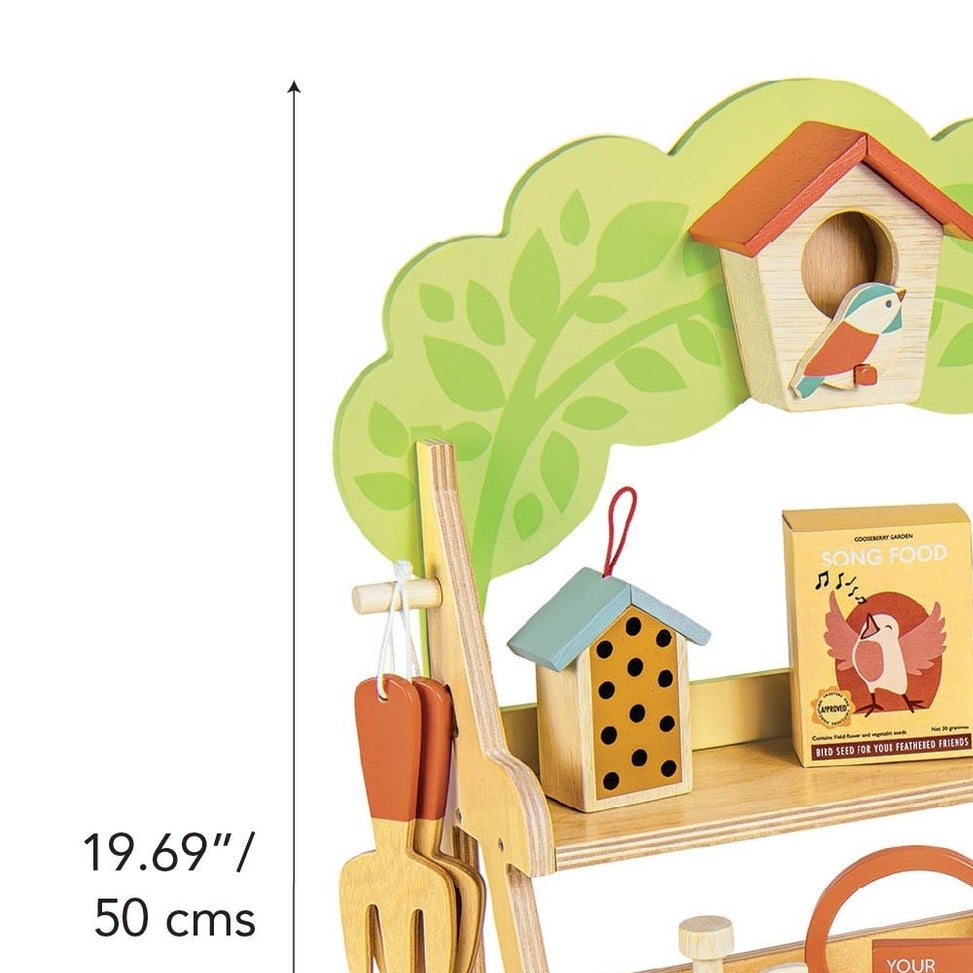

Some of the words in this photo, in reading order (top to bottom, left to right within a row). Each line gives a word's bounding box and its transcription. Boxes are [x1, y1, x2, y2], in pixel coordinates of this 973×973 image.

[854, 534, 889, 543] GOOSEBERRY
[821, 547, 882, 567] SONG
[889, 543, 948, 564] FOOD
[821, 704, 847, 713] APPROVED
[816, 747, 833, 757] BIRD
[836, 746, 854, 756] SEED
[857, 745, 871, 754] FOR
[873, 743, 893, 753] YOUR
[896, 740, 936, 752] FEATHERED
[939, 737, 969, 748] FRIENDS
[886, 958, 936, 973] YOUR
